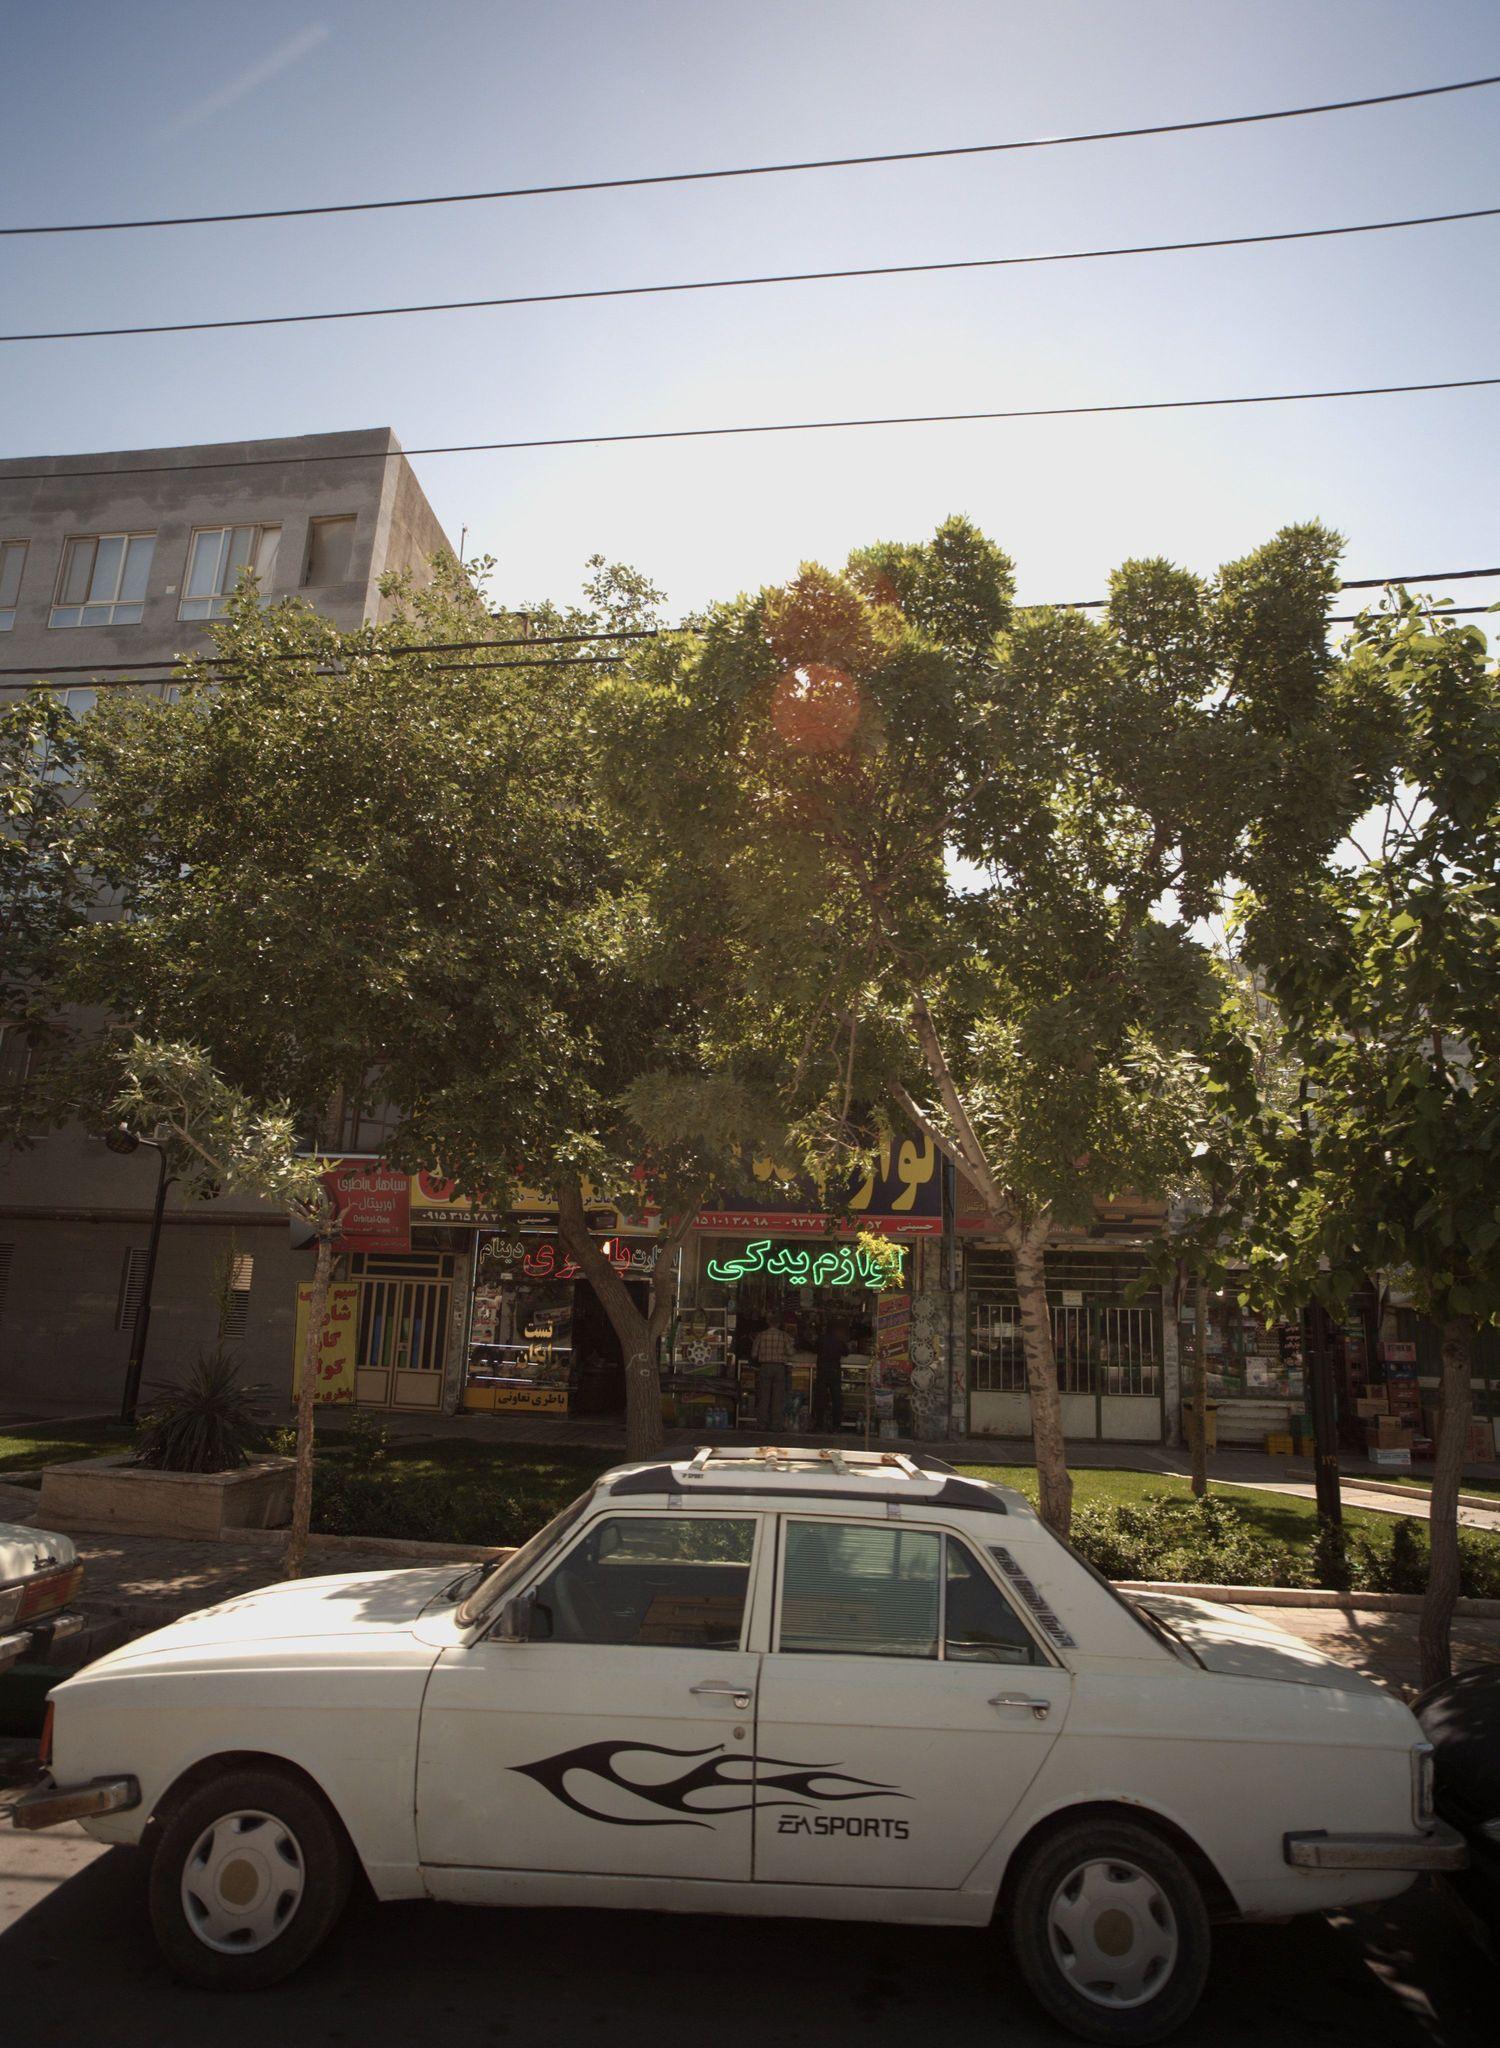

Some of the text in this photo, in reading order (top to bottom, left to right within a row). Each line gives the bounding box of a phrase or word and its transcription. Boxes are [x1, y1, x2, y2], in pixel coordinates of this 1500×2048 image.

[517, 1216, 552, 1225] حسینی
[896, 1223, 934, 1232] حسینی
[479, 1237, 525, 1265] دینام
[706, 1239, 904, 1288] لوازم یدکی
[524, 1320, 553, 1339] تست
[531, 1393, 565, 1407] باطری
